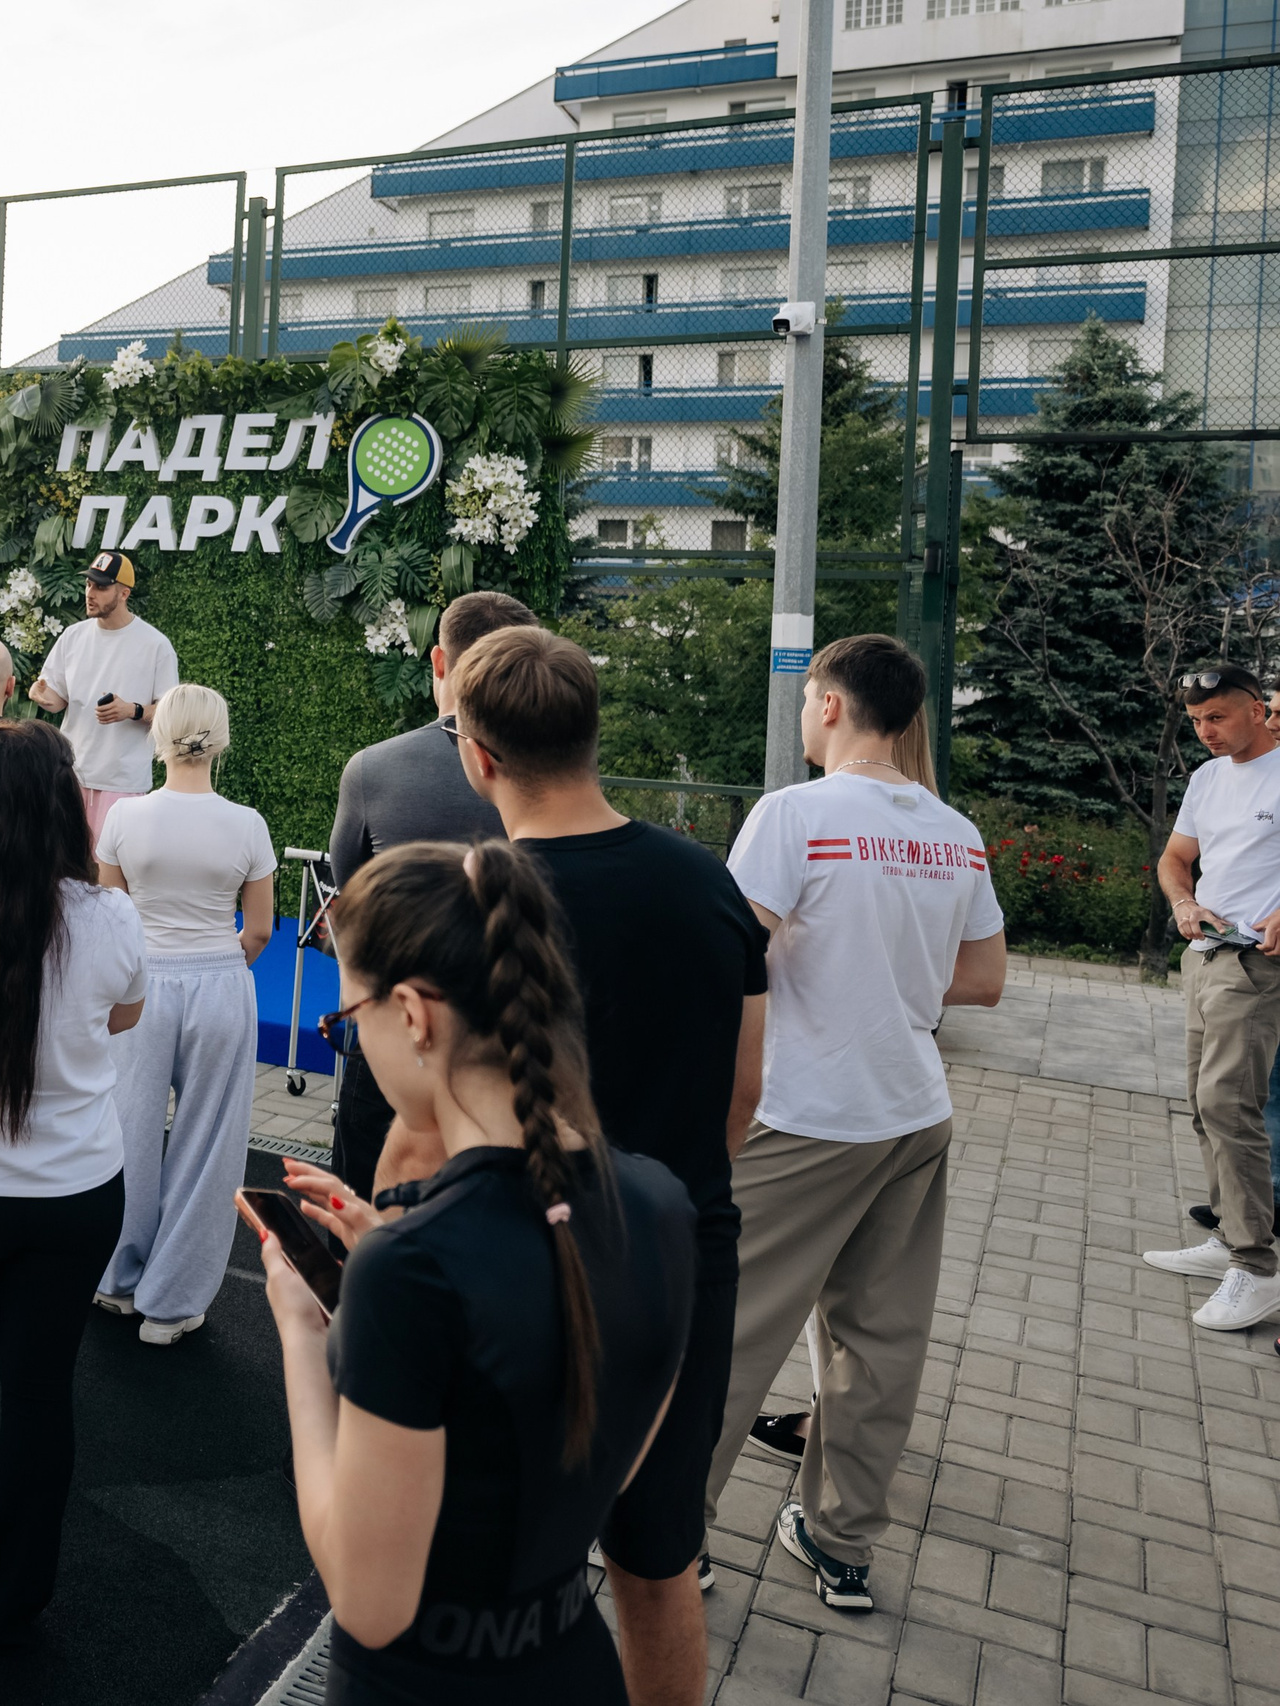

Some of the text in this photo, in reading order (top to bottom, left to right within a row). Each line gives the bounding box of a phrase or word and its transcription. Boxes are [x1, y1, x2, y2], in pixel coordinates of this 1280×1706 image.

[56, 411, 336, 482] ПАДЕЛ
[71, 495, 289, 553] ПАРК
[857, 836, 968, 869] BIKKEMBERGS
[882, 866, 904, 877] STRON
[920, 869, 955, 880] FEARLESS
[419, 1599, 542, 1658] ONA
